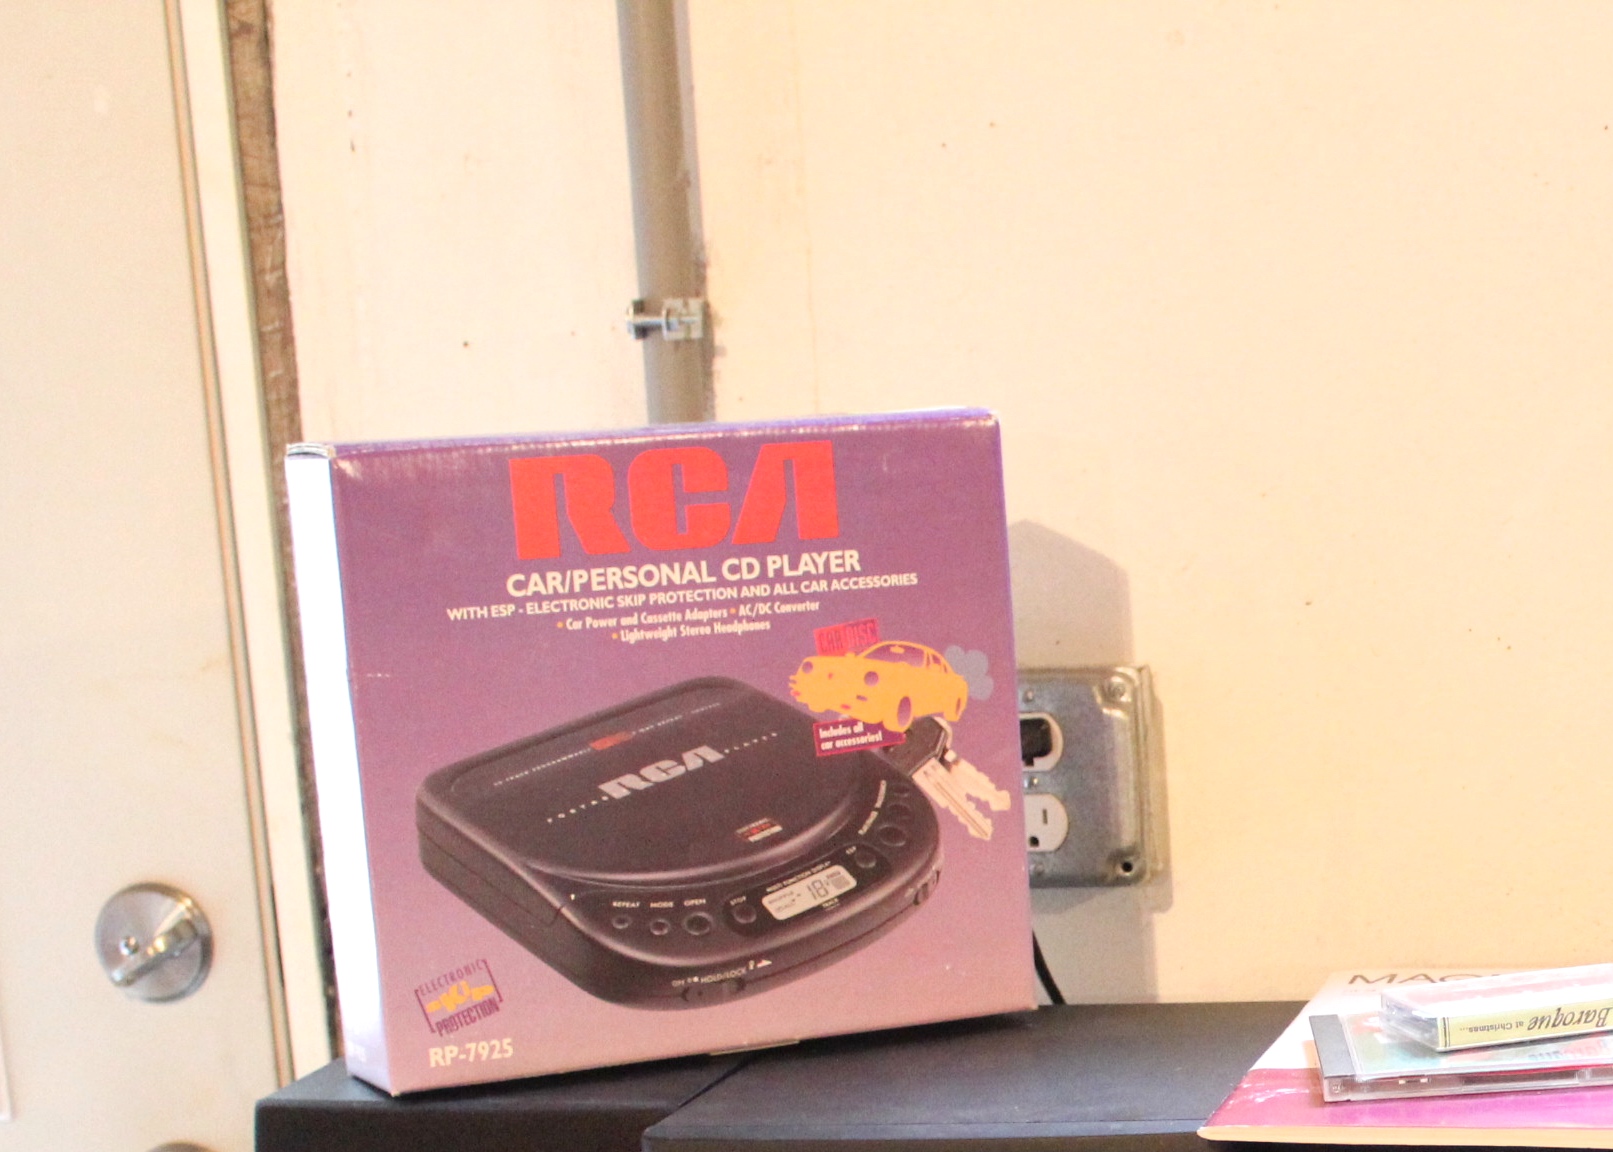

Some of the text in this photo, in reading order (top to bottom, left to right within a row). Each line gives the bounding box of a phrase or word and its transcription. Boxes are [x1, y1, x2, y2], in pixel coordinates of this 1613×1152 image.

[509, 440, 839, 560] RCA
[506, 550, 861, 597] CAR/PERSONAL CD PLAYER
[446, 606, 488, 621] WITH
[491, 604, 515, 618] ESP
[526, 596, 615, 615] ELECTRONIC
[617, 594, 646, 609] SKIP
[650, 587, 737, 606] PROTECTION
[740, 583, 770, 598] AND
[773, 581, 798, 596] ALL
[801, 579, 828, 593] CAR
[831, 572, 918, 592] ACCESSORIES
[566, 600, 820, 631] Car Power and Cassette Adapters AC/DC Converter
[621, 620, 770, 644] Lightweight Stereo Headphones
[819, 720, 864, 739] Includes all
[598, 745, 725, 799] RCA
[420, 960, 484, 996] ELECTRONIC
[435, 997, 500, 1037] PROTECTION
[1527, 1006, 1613, 1031] Baroque
[428, 1037, 514, 1068] RP-7925
